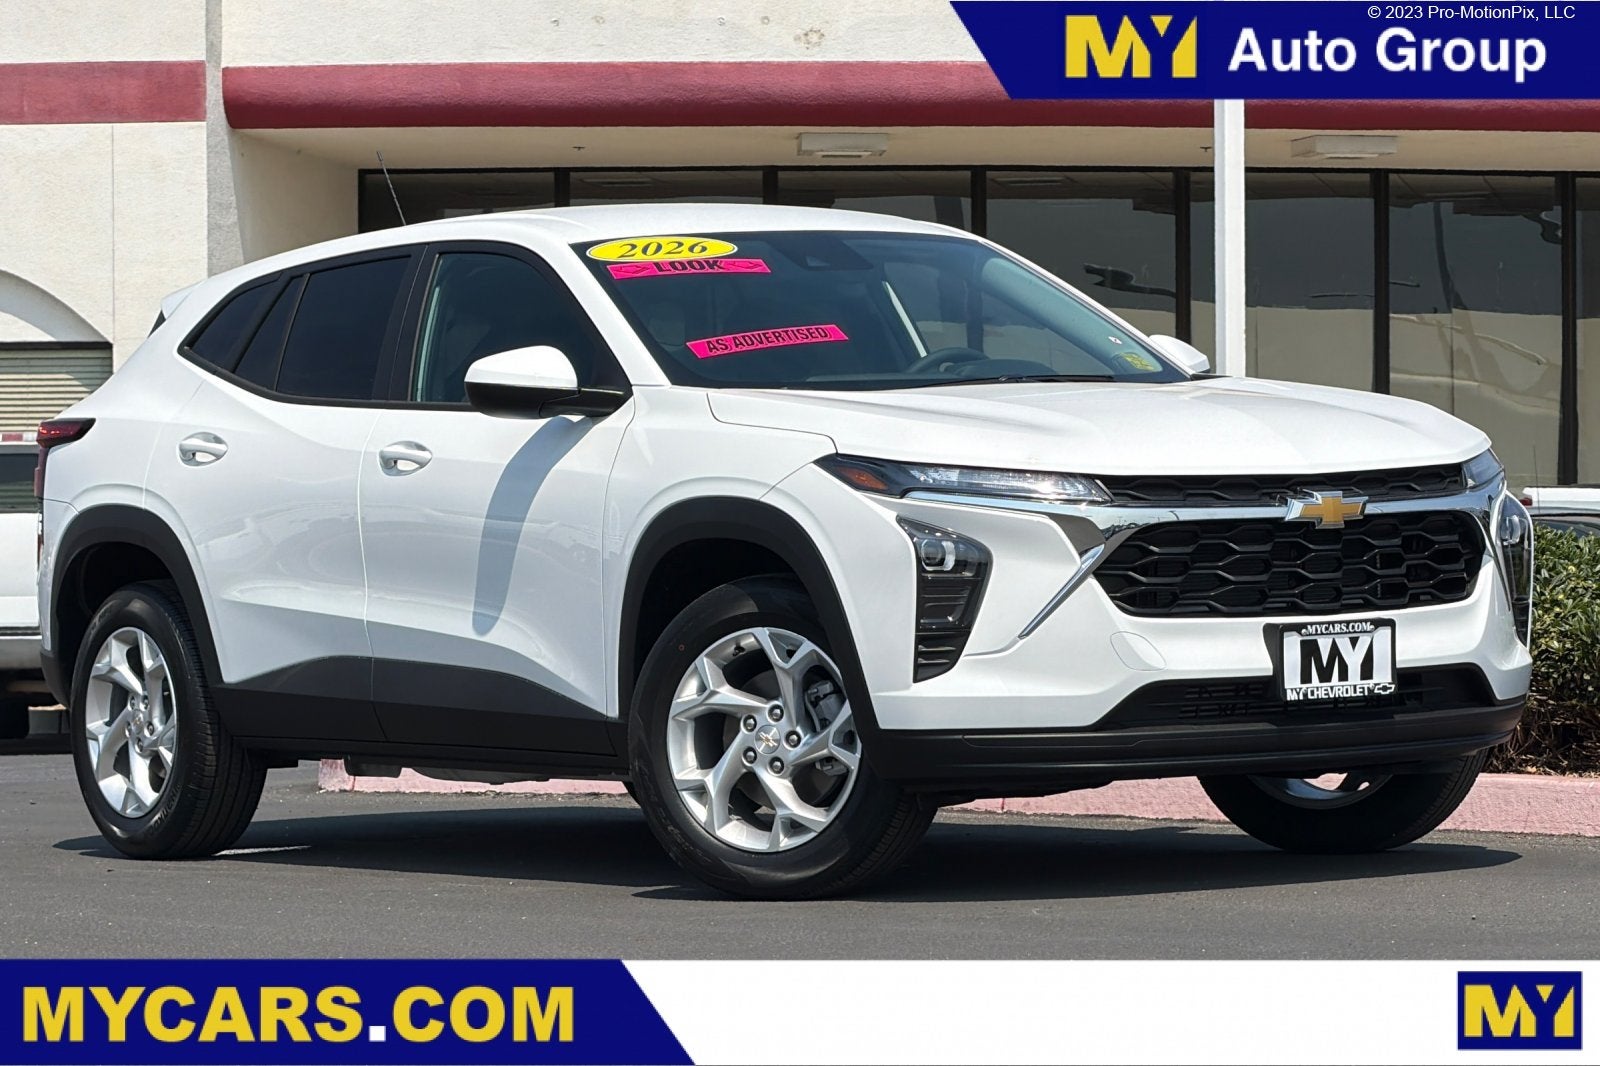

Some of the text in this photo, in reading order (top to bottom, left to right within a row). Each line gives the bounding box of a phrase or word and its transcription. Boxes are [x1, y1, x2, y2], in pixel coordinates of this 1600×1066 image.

[617, 240, 709, 259] 2026
[655, 259, 726, 273] LOOK
[706, 326, 832, 353] AS ADVERTISED
[1307, 622, 1371, 634] MYCARS.COM
[1299, 634, 1374, 685] MY
